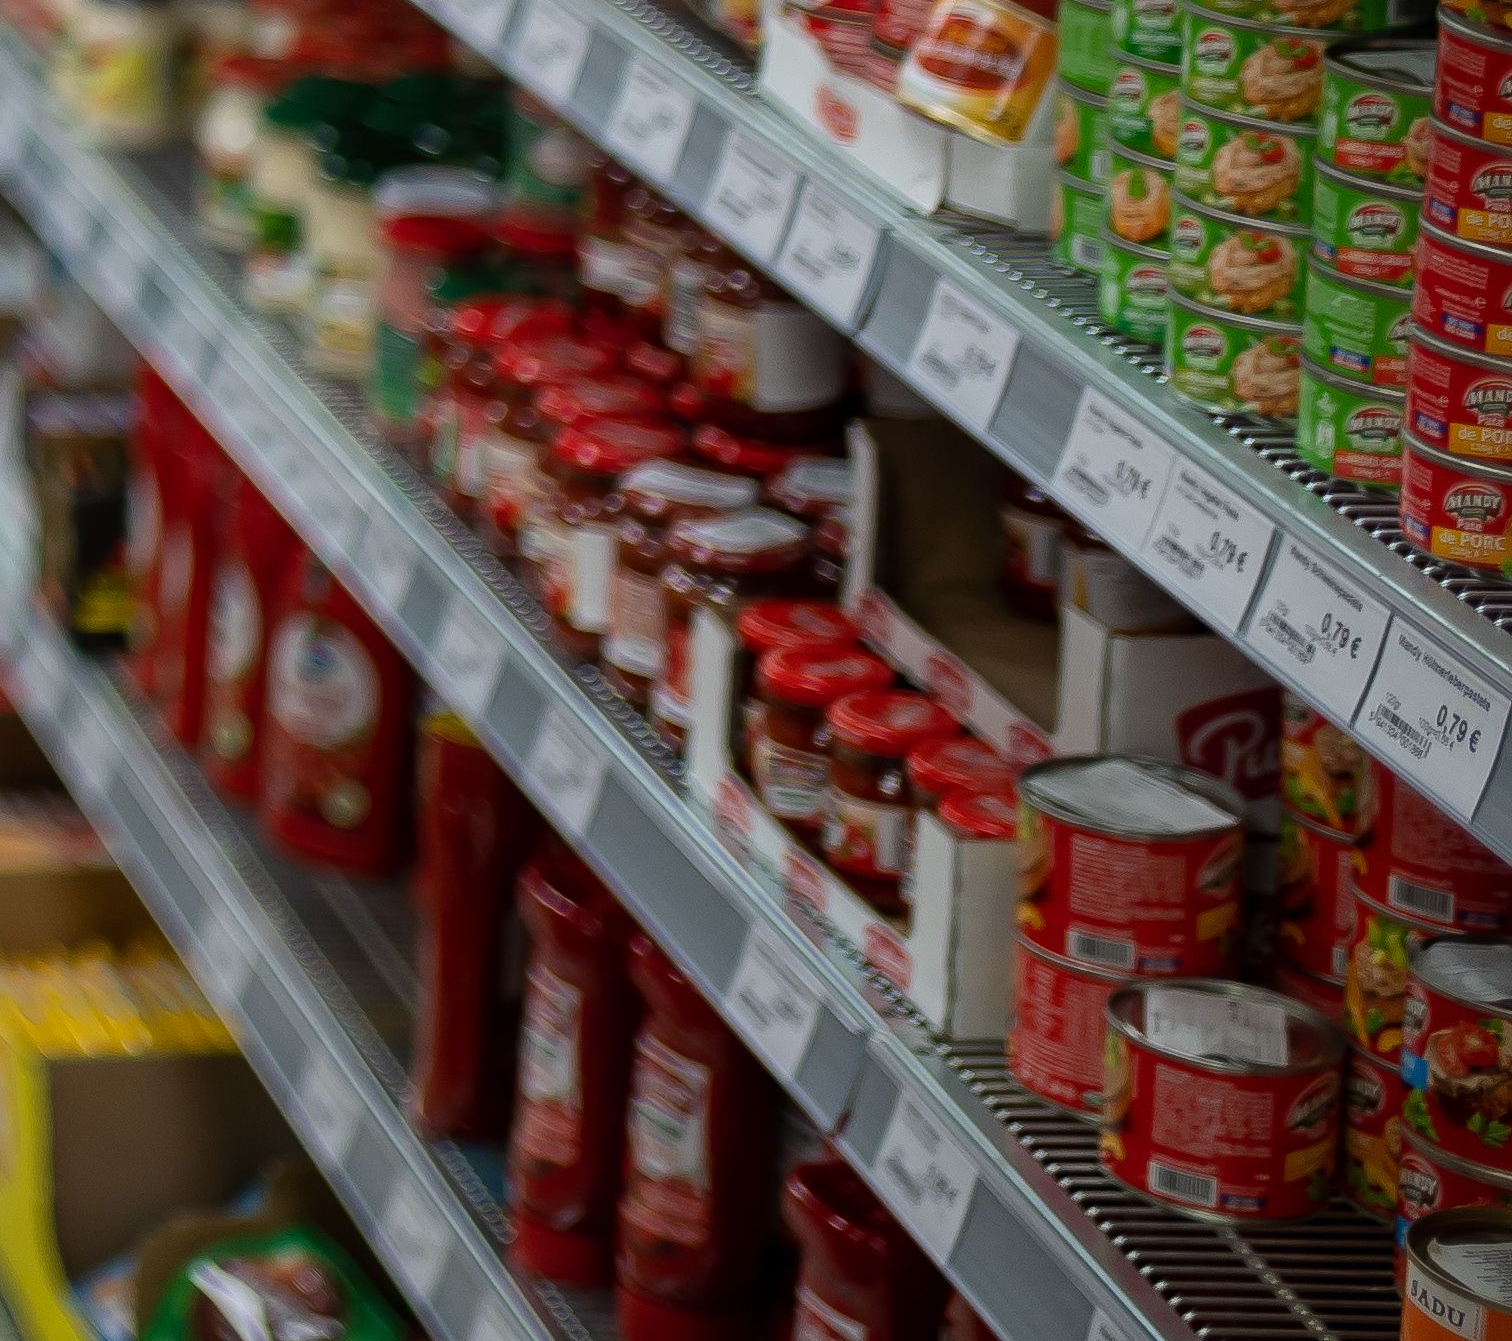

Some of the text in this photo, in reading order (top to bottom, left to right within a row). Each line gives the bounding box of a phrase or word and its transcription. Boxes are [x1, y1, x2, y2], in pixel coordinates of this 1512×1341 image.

[1478, 174, 1512, 191] MAN
[1467, 388, 1512, 410] MAND
[1480, 428, 1512, 444] POR
[1445, 492, 1503, 514] MANDY
[1439, 530, 1506, 552] de PORC
[1321, 612, 1363, 659] 0,79 €
[1436, 704, 1482, 753] 0,79 €
